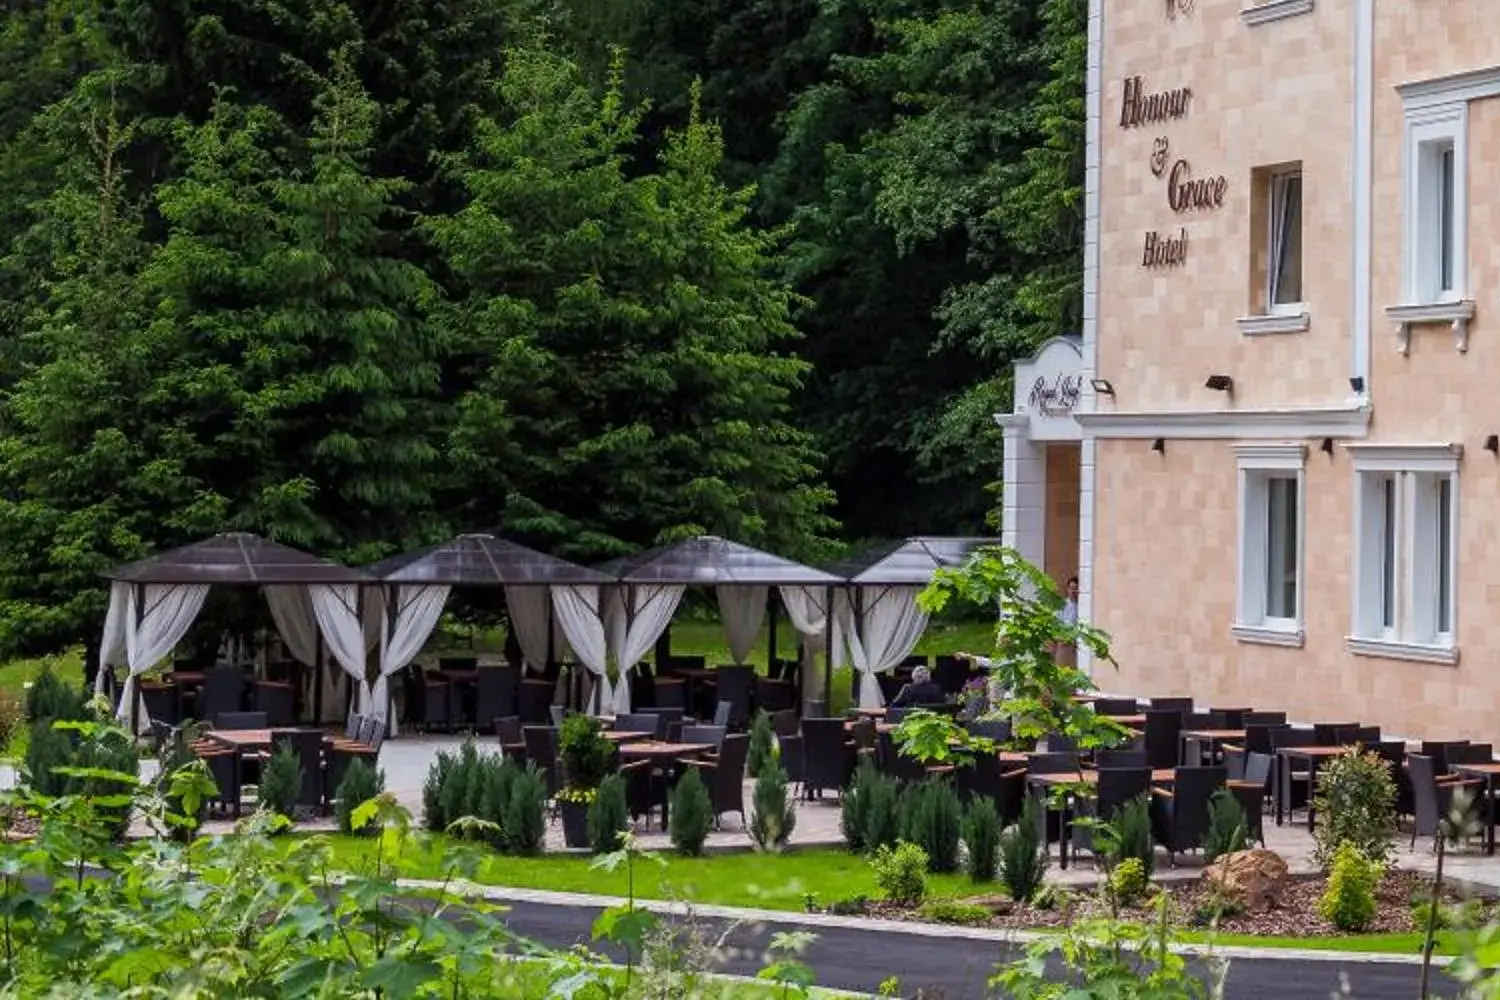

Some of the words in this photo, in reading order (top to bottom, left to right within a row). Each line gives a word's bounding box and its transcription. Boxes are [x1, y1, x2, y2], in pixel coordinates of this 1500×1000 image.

[1120, 75, 1193, 129] Honour
[1151, 135, 1169, 177] &
[1168, 158, 1228, 214] Grace
[1142, 227, 1189, 268] Hotel
